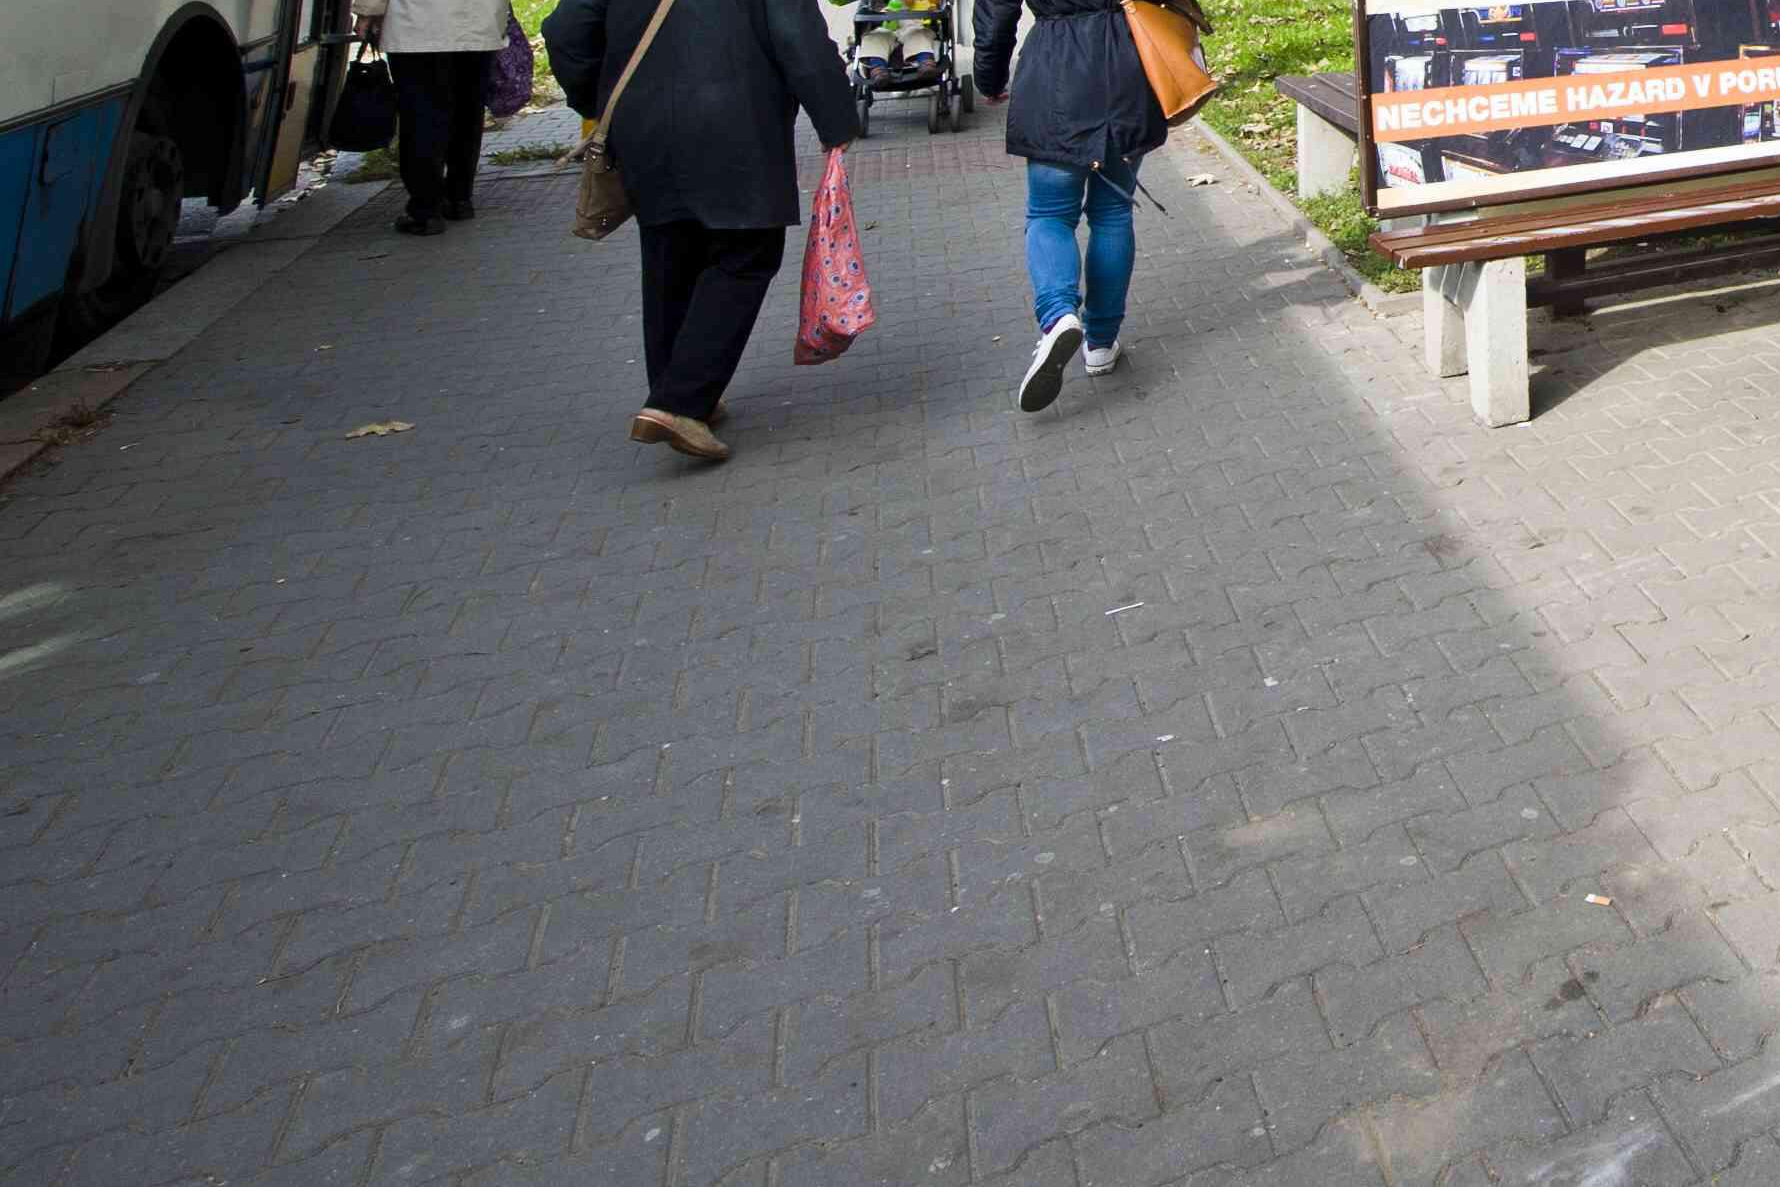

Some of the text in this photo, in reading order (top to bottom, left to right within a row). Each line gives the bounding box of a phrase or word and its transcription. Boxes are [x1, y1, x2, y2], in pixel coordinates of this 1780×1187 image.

[1376, 88, 1559, 132] NECHCEME
[1566, 76, 1686, 111] HAZARD
[1692, 73, 1711, 98] V
